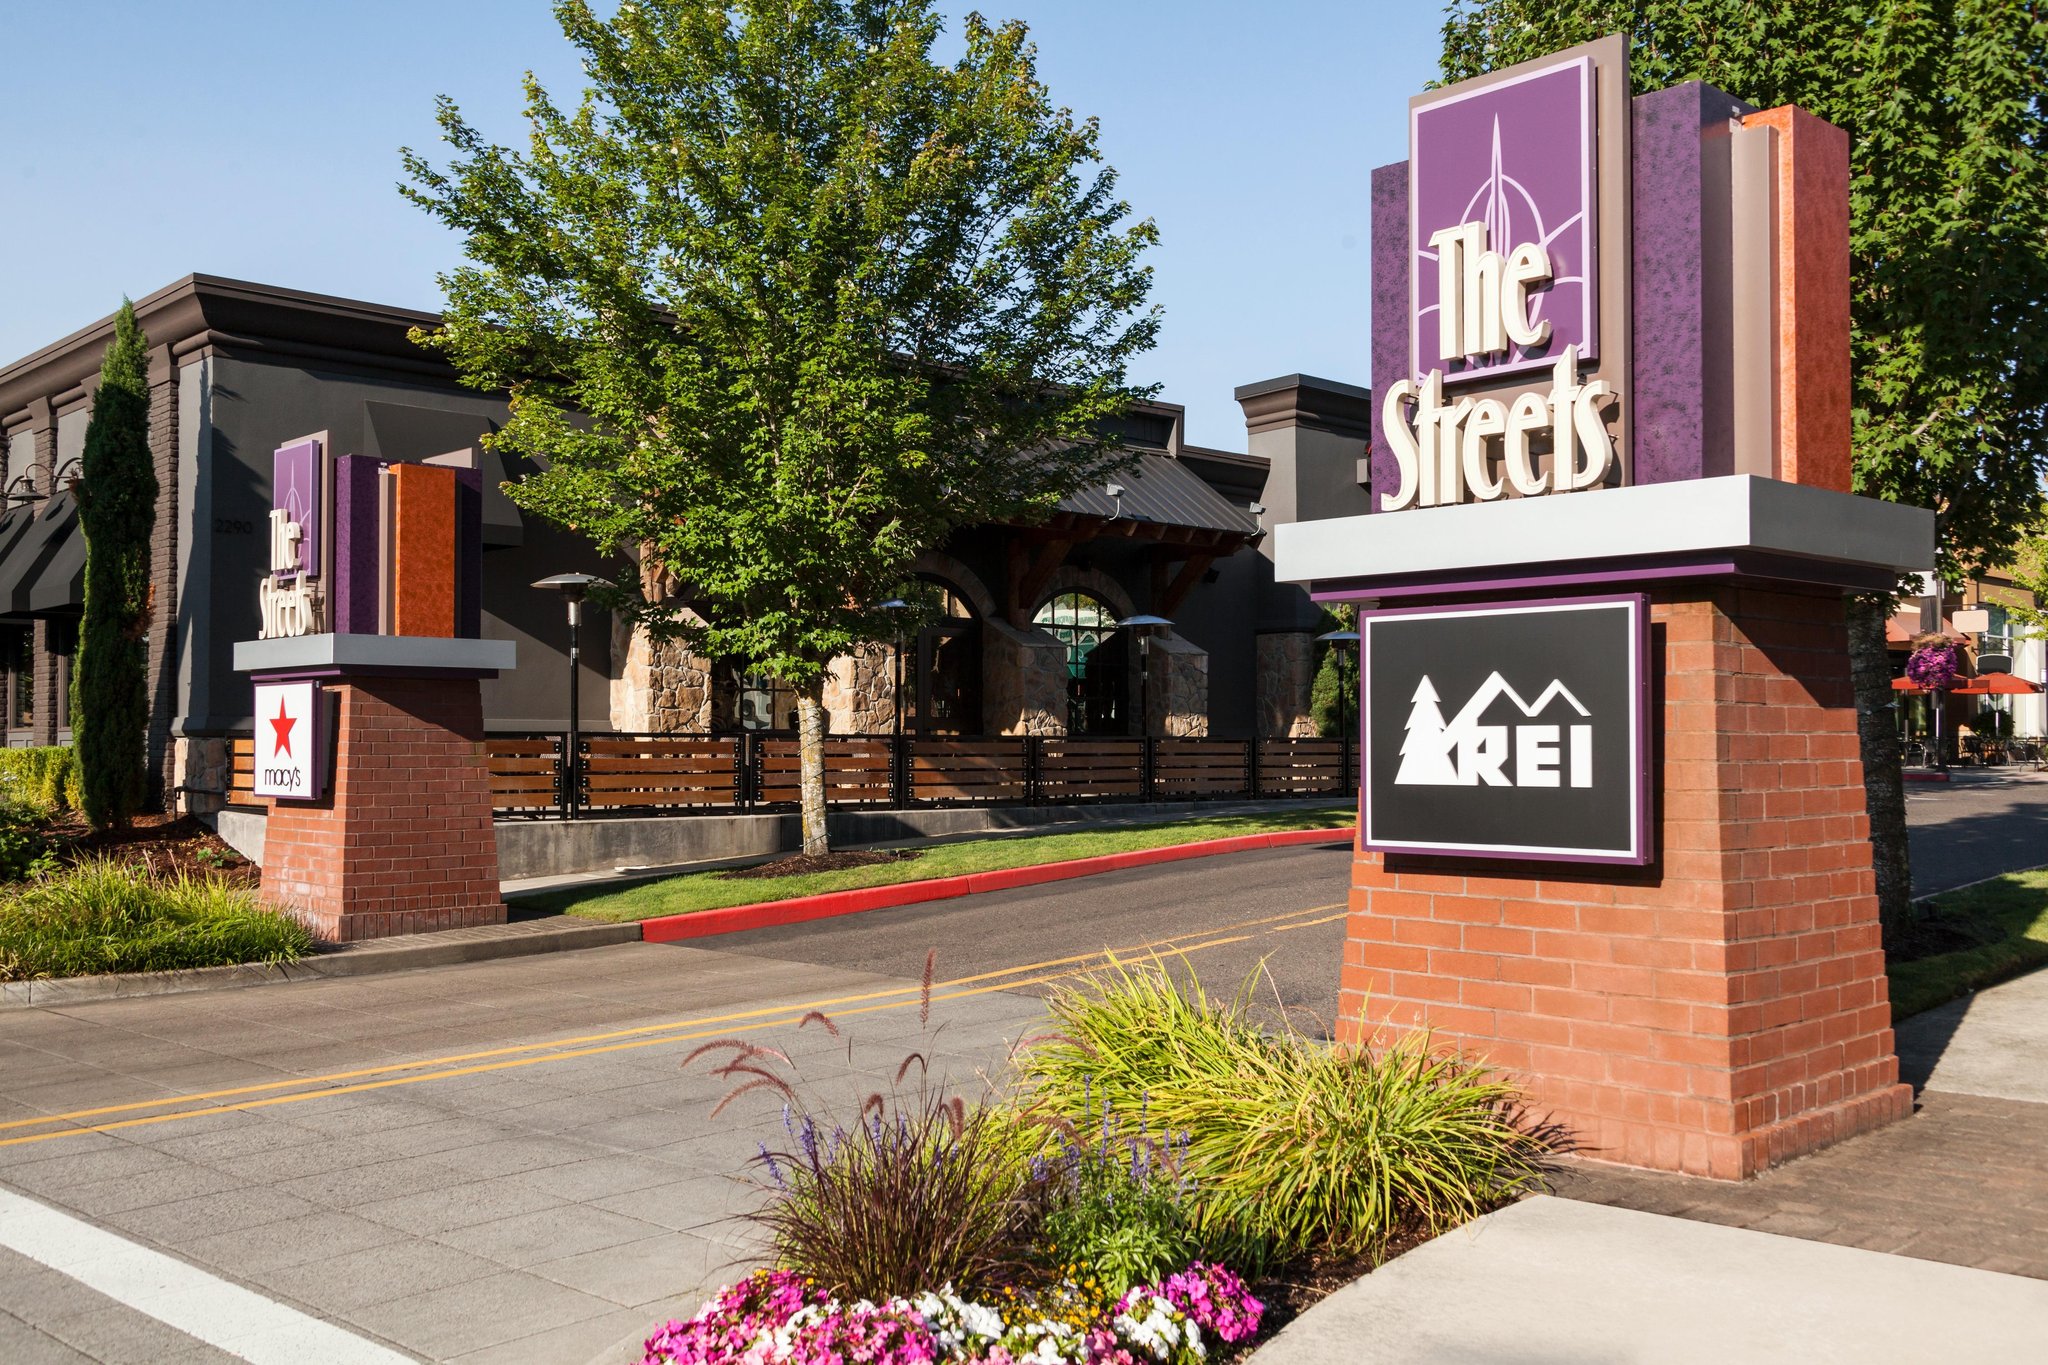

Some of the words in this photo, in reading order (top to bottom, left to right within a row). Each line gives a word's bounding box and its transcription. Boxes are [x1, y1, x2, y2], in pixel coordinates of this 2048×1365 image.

[1428, 221, 1553, 361] The
[1381, 343, 1612, 511] Streets
[269, 508, 303, 571] The
[258, 569, 313, 640] Streets
[264, 767, 301, 791] macy's
